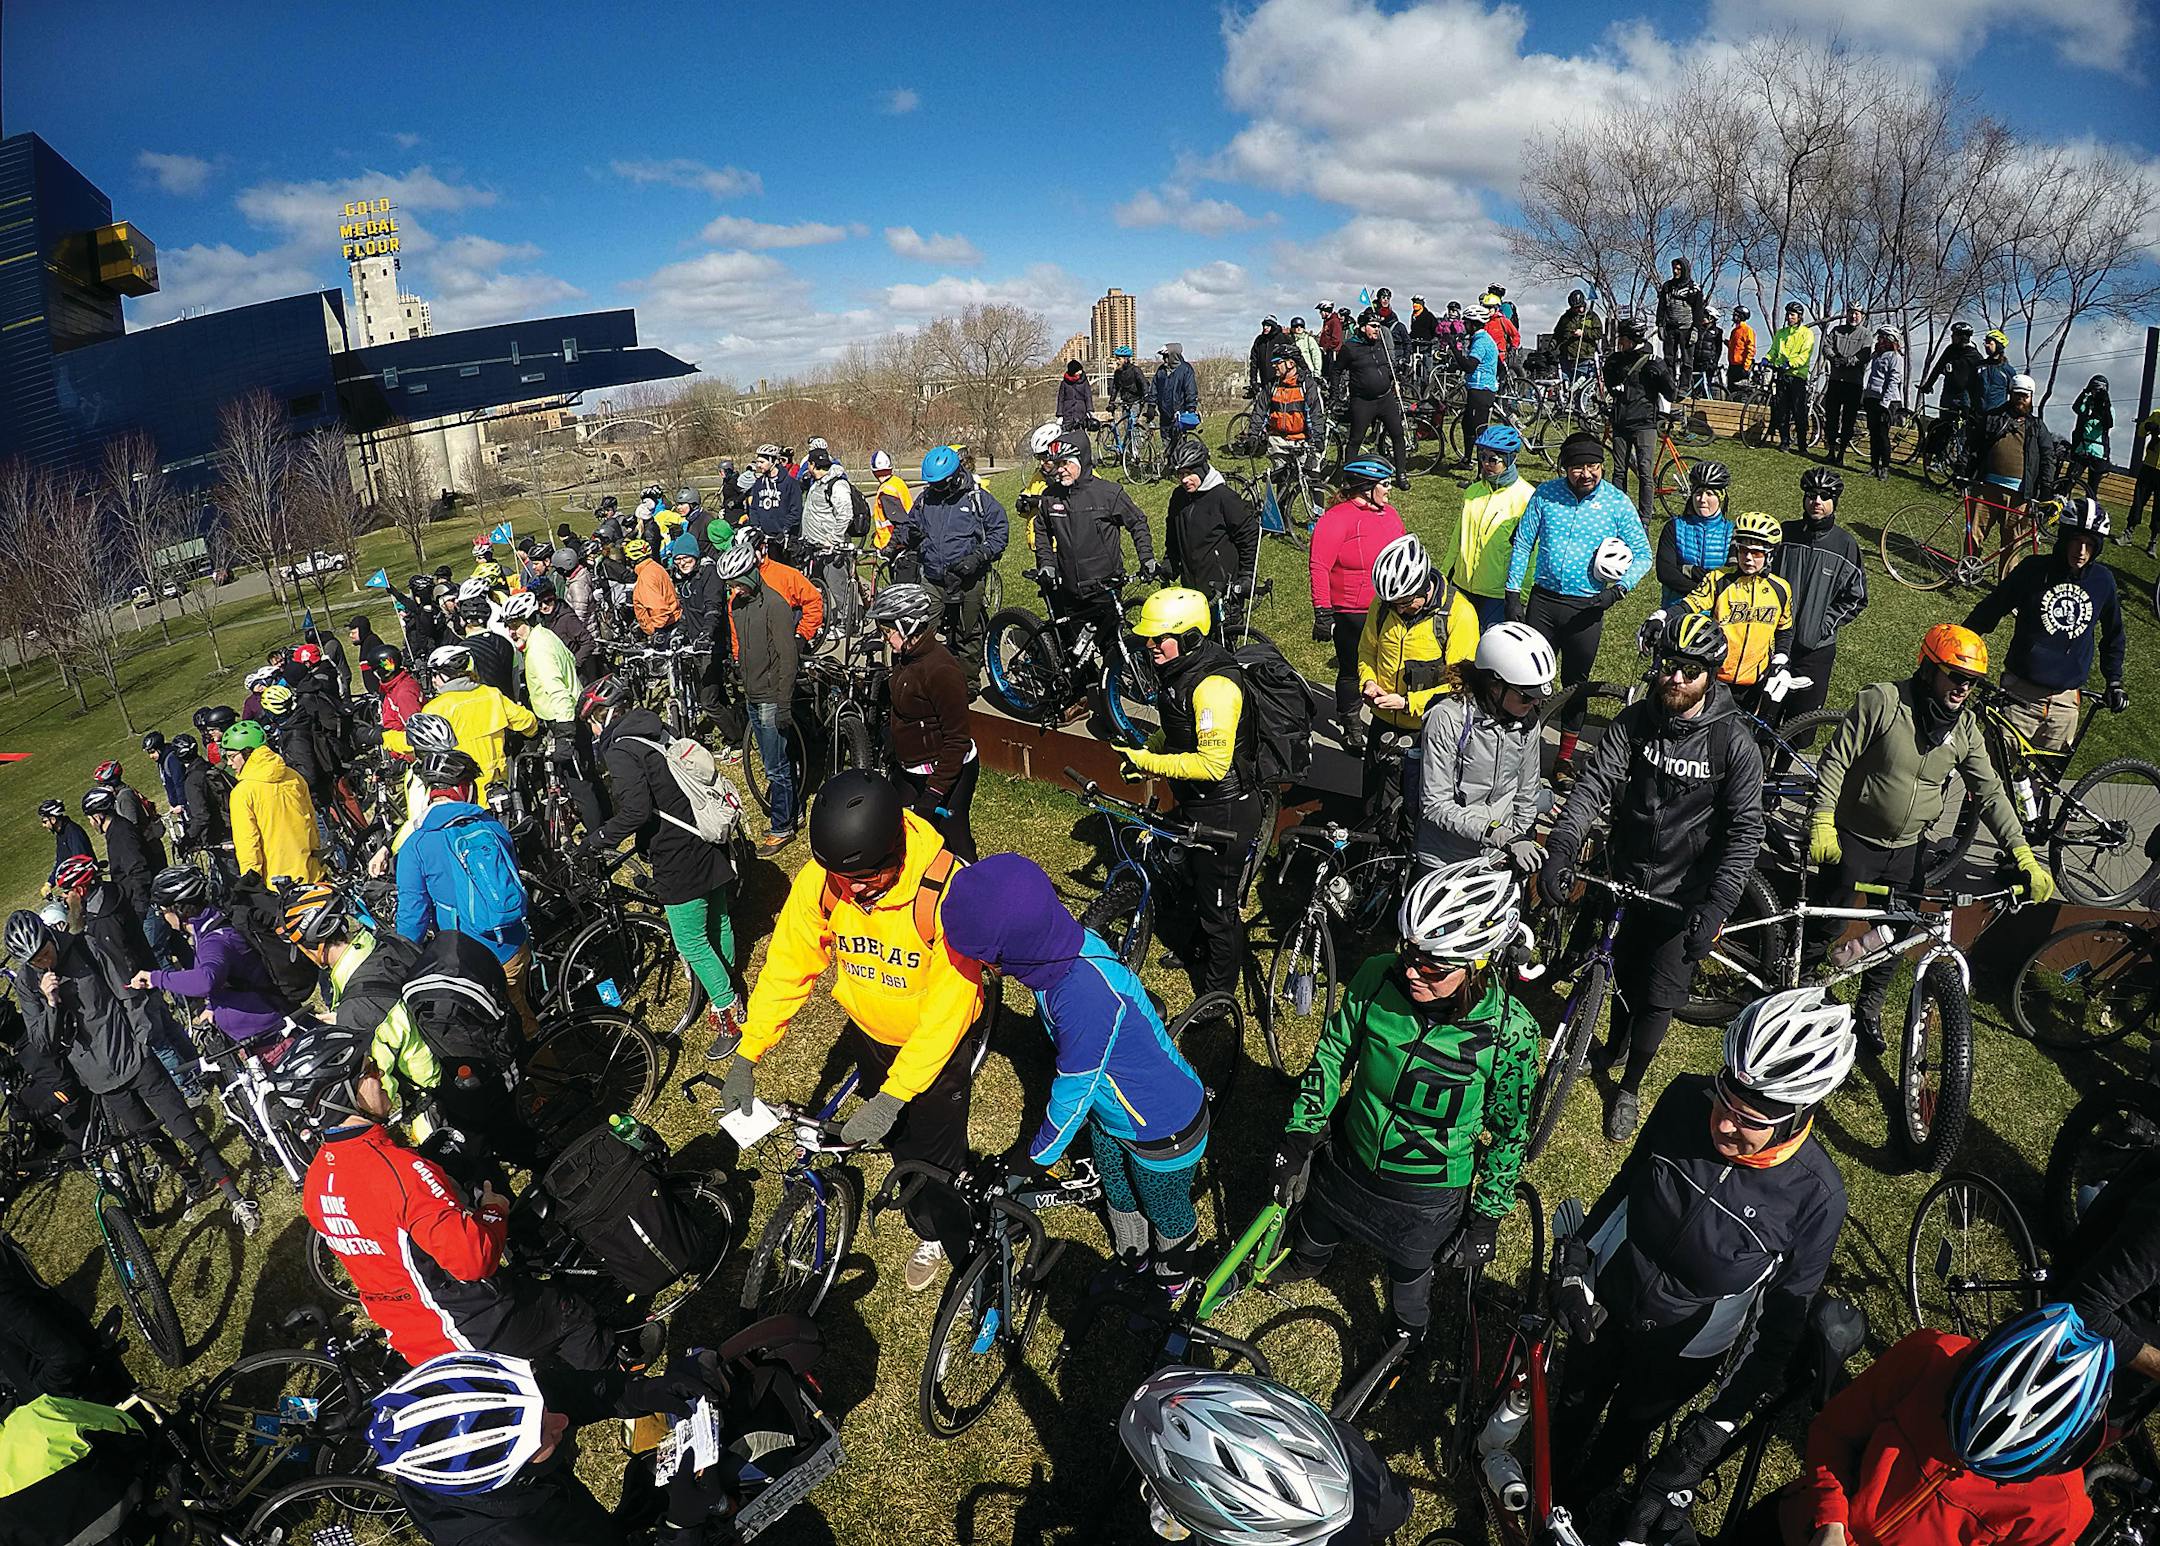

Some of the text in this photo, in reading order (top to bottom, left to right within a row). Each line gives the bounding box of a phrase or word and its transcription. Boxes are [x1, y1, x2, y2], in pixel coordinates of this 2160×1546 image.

[345, 198, 390, 217] GOLD
[339, 218, 399, 239] MEDAL
[343, 237, 400, 258] FLOUR
[832, 931, 920, 969] ABELA'S
[881, 971, 907, 989] 1961
[412, 1160, 446, 1199] thrive
[319, 1194, 349, 1217] RIDE
